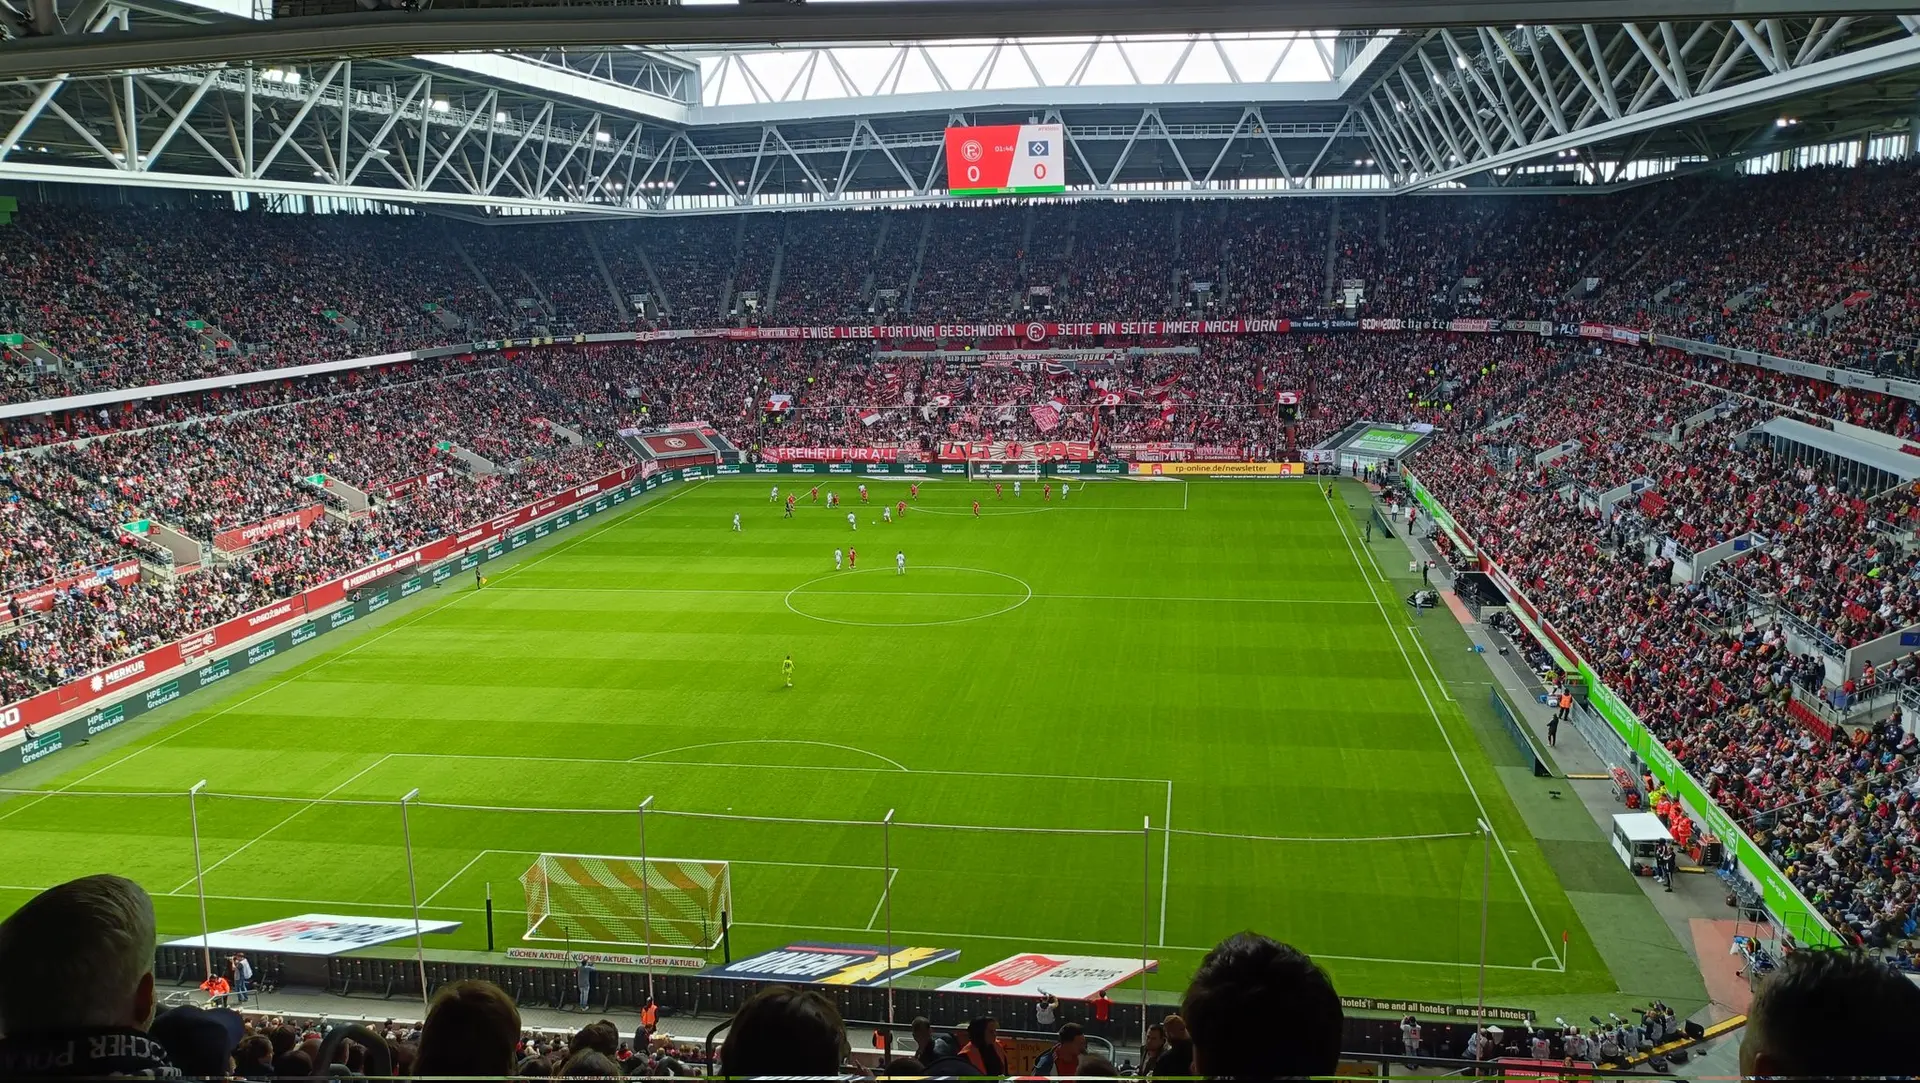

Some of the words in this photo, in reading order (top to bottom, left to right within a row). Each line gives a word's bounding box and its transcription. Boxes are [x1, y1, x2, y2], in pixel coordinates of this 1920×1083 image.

[967, 165, 980, 182] 0
[1033, 163, 1047, 180] 0
[802, 326, 836, 339] EWIGE
[841, 325, 875, 339] LIEBE
[880, 325, 935, 338] FORTUNA
[939, 324, 1016, 337] GESCHWOR'N
[1057, 322, 1093, 335] SEITE
[1098, 322, 1116, 335] AN
[1120, 321, 1157, 334] SEITE
[1162, 321, 1199, 333] IMMER
[1204, 320, 1240, 333] NACH
[1244, 319, 1283, 332] VORN'
[779, 449, 837, 460] FREIHEIT
[841, 448, 868, 460] FÜR
[1175, 464, 1268, 473] rp-online.de/newsletter
[350, 568, 377, 587] MERKUR
[331, 610, 341, 621] HPE
[331, 614, 355, 628] GreenLake
[291, 627, 302, 638] HPE
[292, 630, 316, 646] GreenLake
[248, 645, 260, 657] HPE
[249, 648, 276, 665] GreenLake
[105, 660, 145, 683] MERKUR
[199, 665, 213, 678] HPE
[200, 668, 230, 686] GreenLake
[146, 688, 161, 701] HPE
[147, 690, 180, 709] GreenLake
[87, 712, 104, 727] HPE
[88, 715, 125, 735] GreenLake
[21, 739, 39, 755] HPE
[22, 741, 63, 764] GreenLake
[509, 949, 538, 959] KÜCHEN
[539, 952, 569, 960] AKTUELL
[573, 953, 601, 962] KÜCHEN
[603, 955, 633, 964] AKTUELL
[638, 957, 667, 966] KÜCHEN
[669, 958, 700, 968] AKTUELL
[1341, 998, 1367, 1008] hotels
[1376, 1002, 1390, 1010] me
[1391, 1001, 1406, 1011] and
[1407, 1002, 1418, 1012] all
[1419, 1003, 1446, 1014] hotels
[1456, 1007, 1469, 1016] me
[1470, 1008, 1487, 1017] and
[1487, 1009, 1498, 1018] all
[1499, 1010, 1527, 1020] hotels
